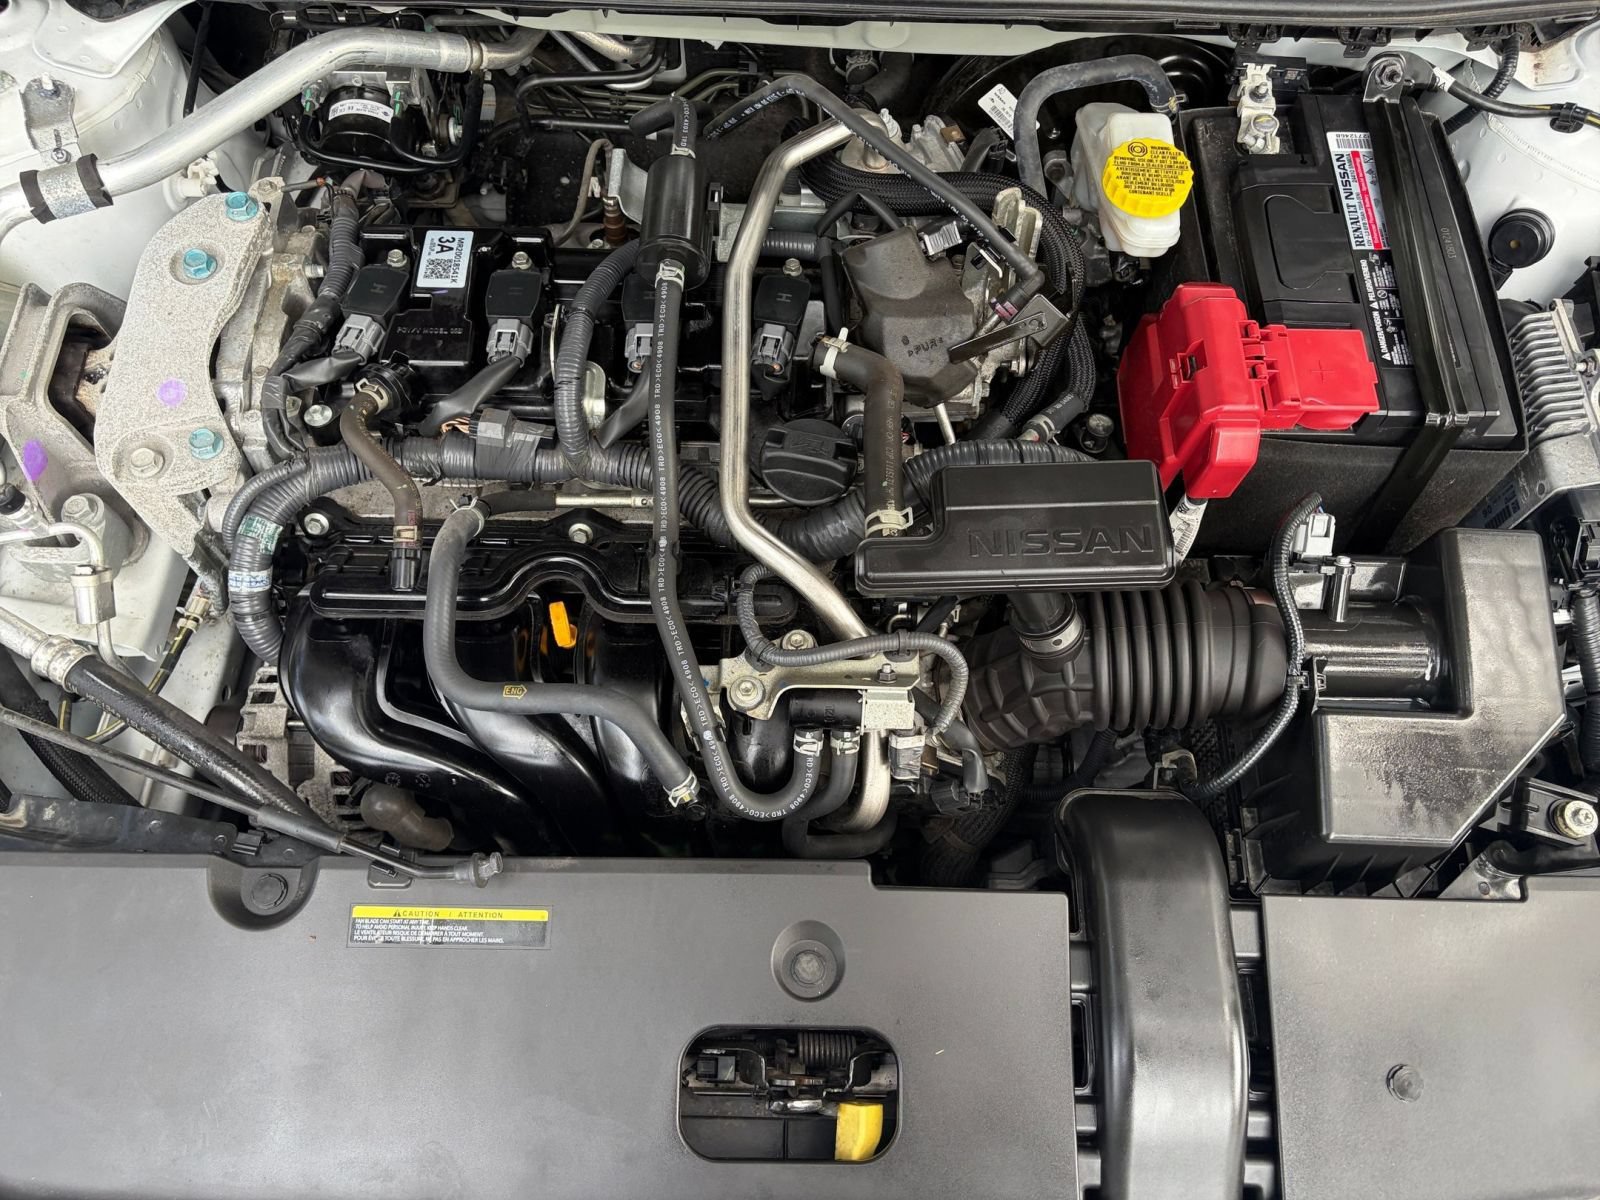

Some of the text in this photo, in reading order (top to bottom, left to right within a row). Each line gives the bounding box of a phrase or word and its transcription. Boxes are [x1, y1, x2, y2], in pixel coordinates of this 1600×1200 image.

[1334, 153, 1366, 247] RENAULT NISSAN
[435, 236, 456, 254] 3A
[1360, 259, 1388, 353] DANGER/POISON PELIGRO/VENENO
[968, 525, 1155, 558] NISSAN
[505, 687, 523, 695] ENG
[458, 911, 503, 919] ATTENTION
